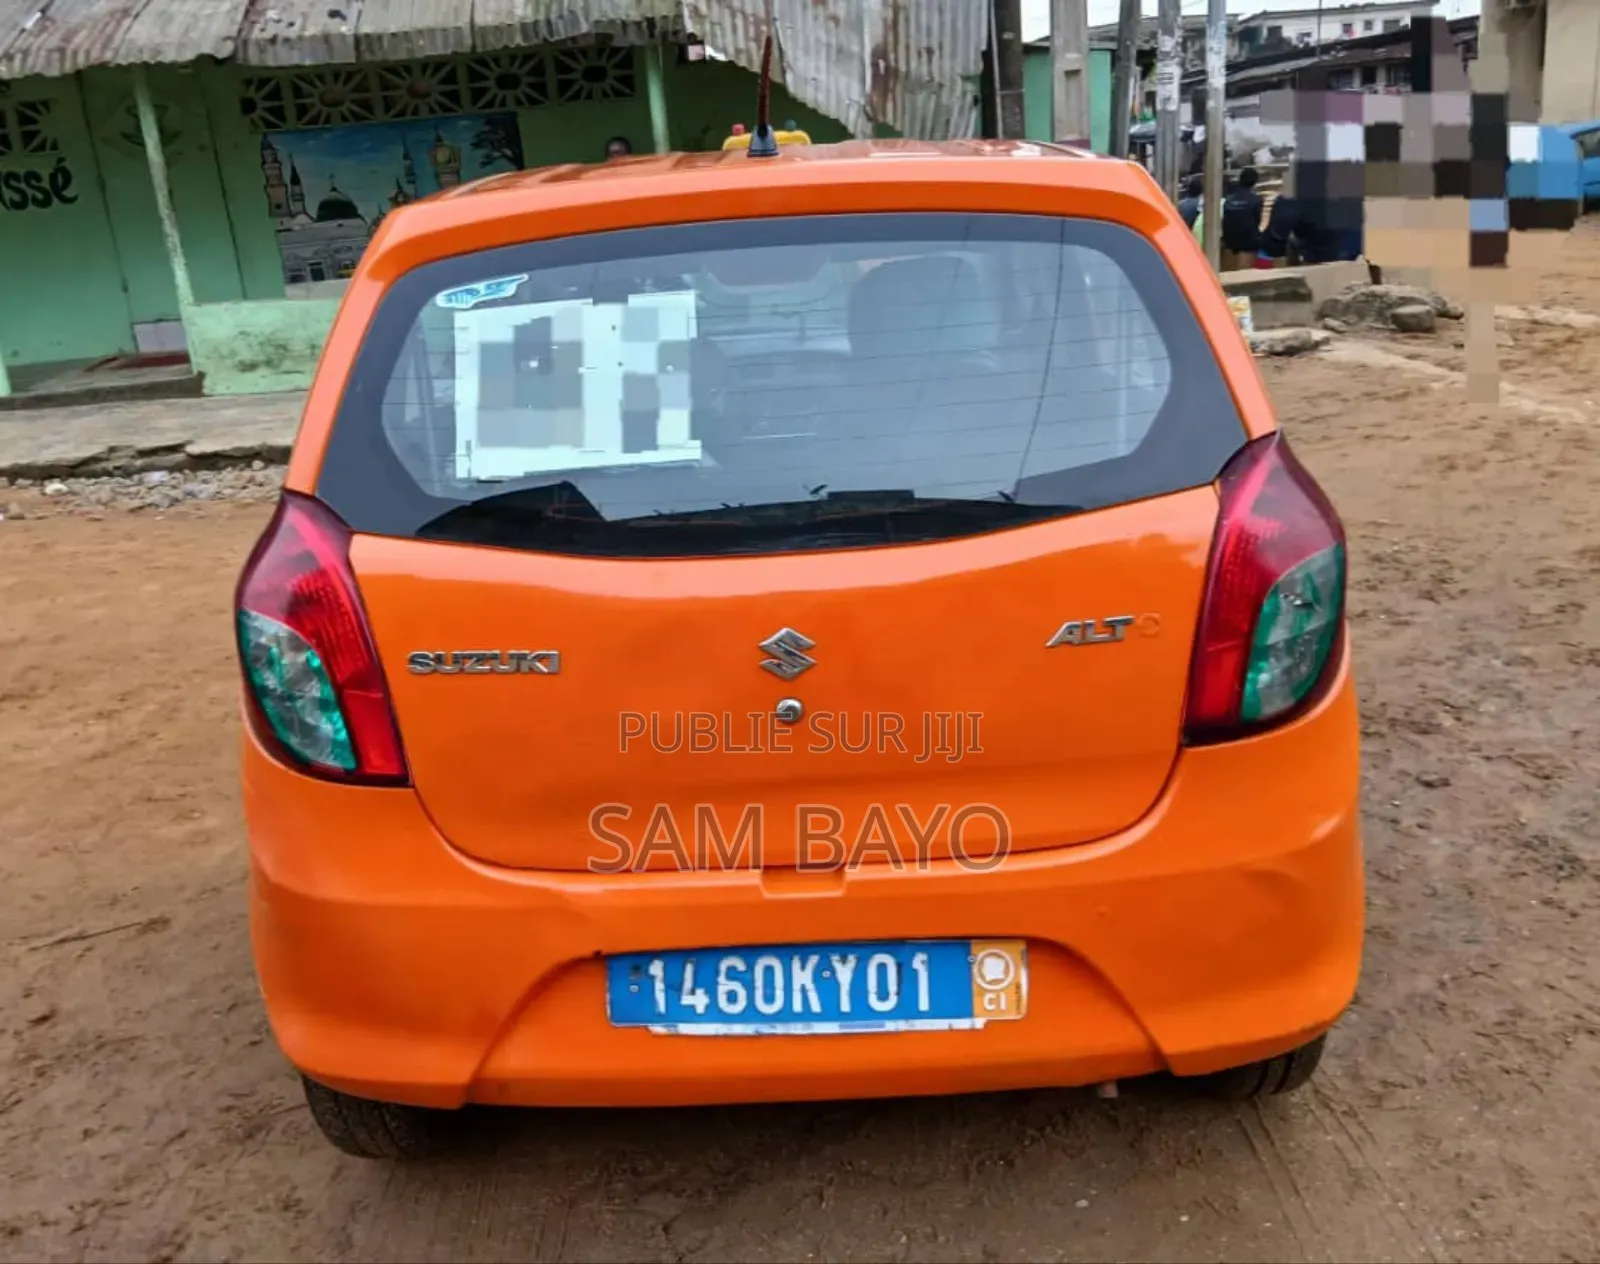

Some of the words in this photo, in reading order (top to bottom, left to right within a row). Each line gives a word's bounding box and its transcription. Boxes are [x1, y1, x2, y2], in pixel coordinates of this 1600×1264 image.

[0, 156, 80, 211] ssé
[407, 650, 561, 674] SUZUKI
[983, 991, 1006, 1011] CI
